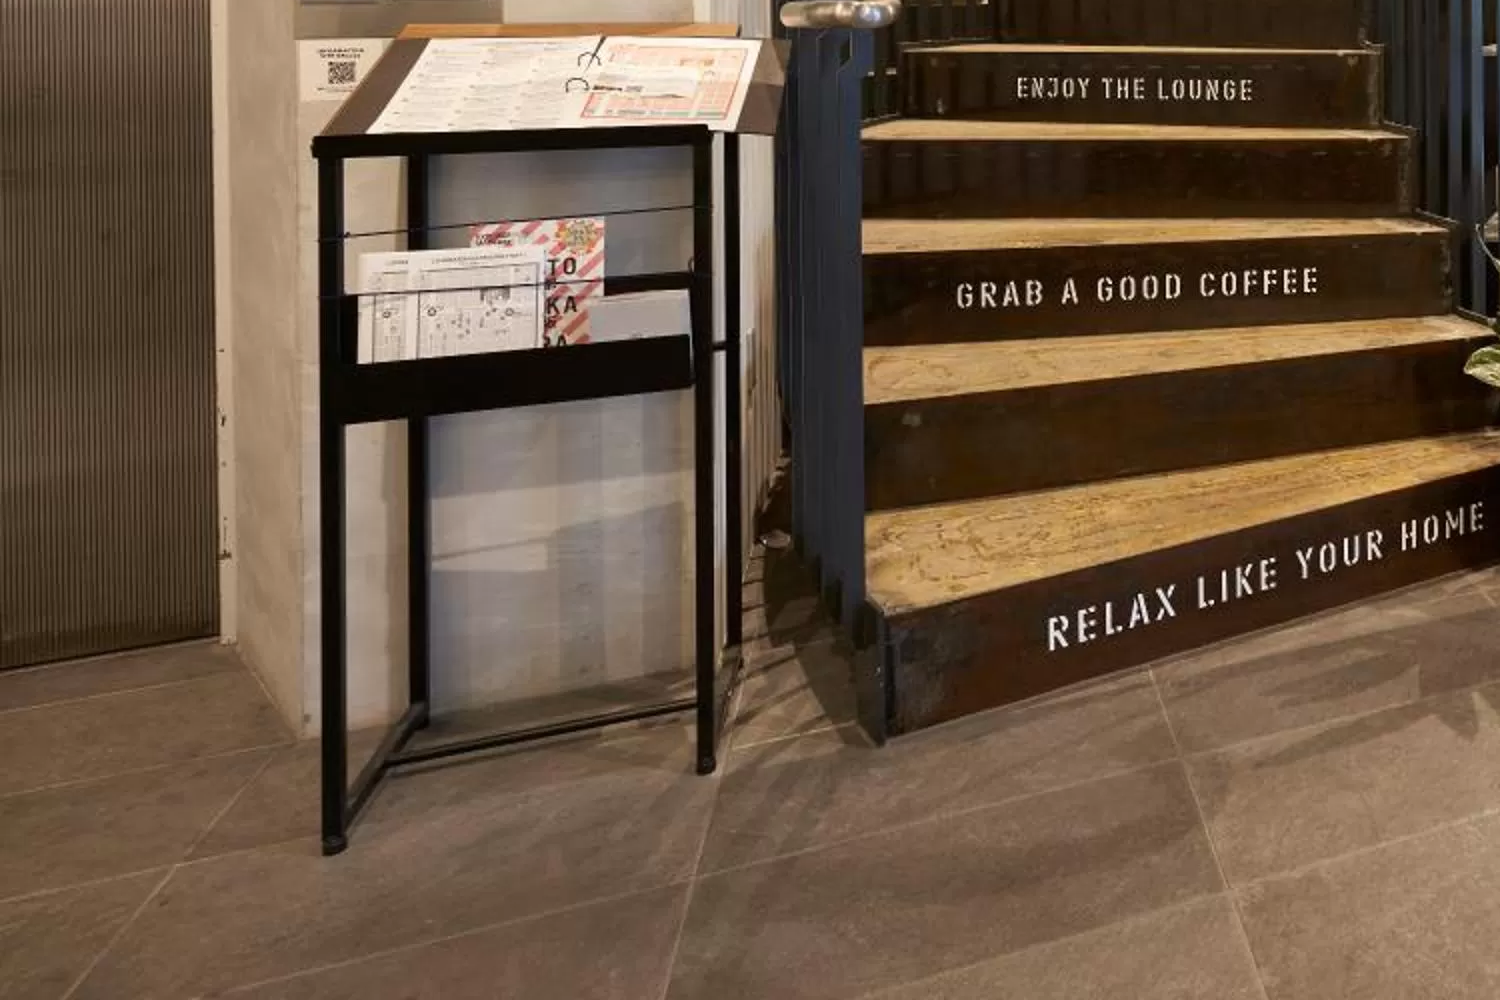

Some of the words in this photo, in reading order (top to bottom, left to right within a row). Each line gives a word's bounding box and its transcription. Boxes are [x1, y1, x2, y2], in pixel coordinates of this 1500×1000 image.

[1017, 77, 1091, 99] ENJOY
[1101, 77, 1145, 99] THE
[1157, 78, 1254, 101] LOUNGE
[956, 279, 1044, 309] GRAB
[1061, 277, 1079, 305] A
[1097, 274, 1182, 302] GOOD
[1199, 267, 1318, 298] COFFEE
[1046, 585, 1177, 651] RELAX
[1197, 557, 1278, 609] LIKE
[1296, 529, 1385, 580] YOUR
[1400, 501, 1485, 552] HOME
